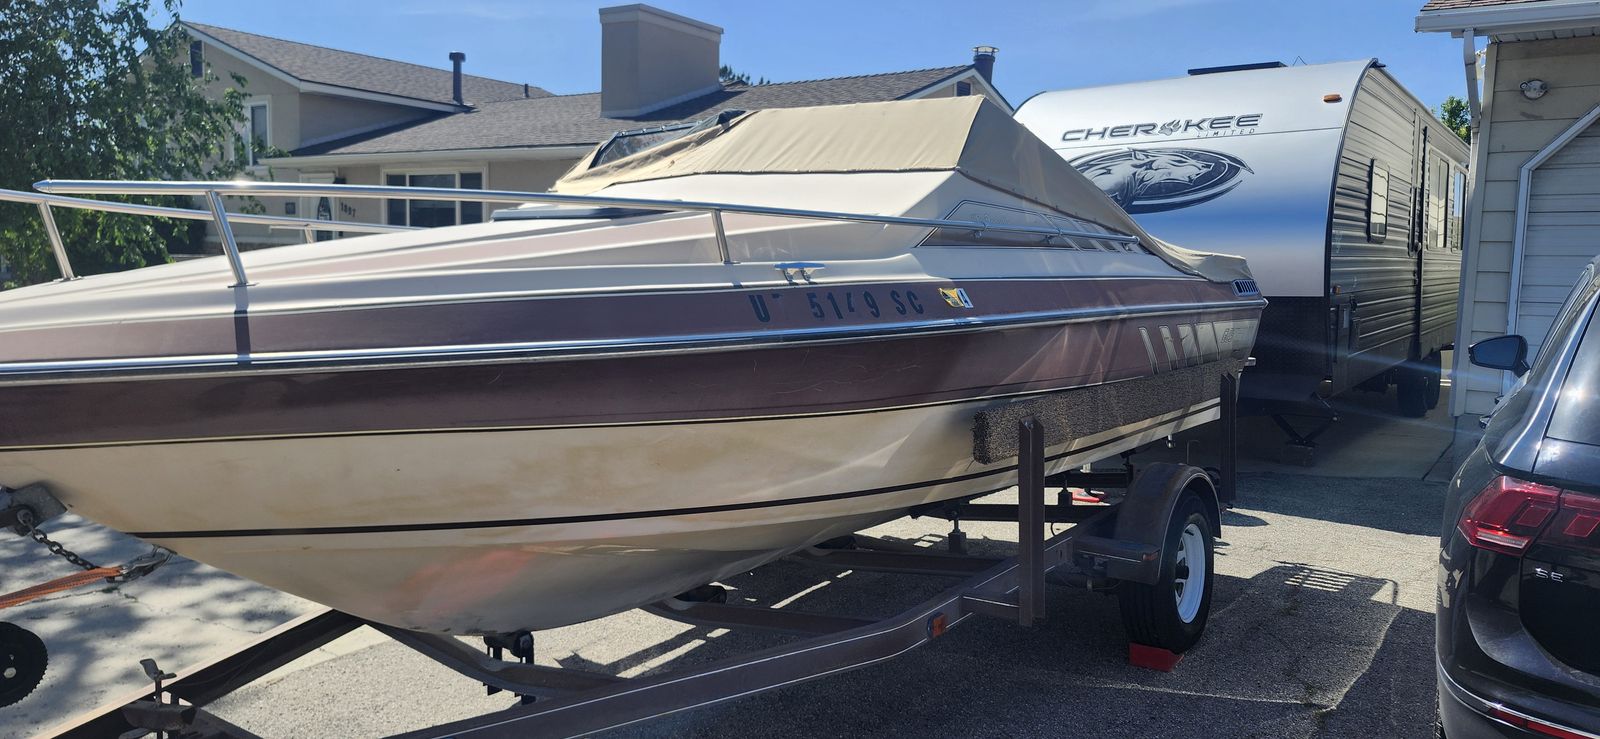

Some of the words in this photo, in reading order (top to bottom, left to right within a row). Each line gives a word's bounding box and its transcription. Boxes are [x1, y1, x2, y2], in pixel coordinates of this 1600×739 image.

[1061, 113, 1263, 143] CHEROKEE
[1197, 128, 1256, 138] LIMITED
[889, 289, 925, 315] SC
[1535, 567, 1564, 583] SE
